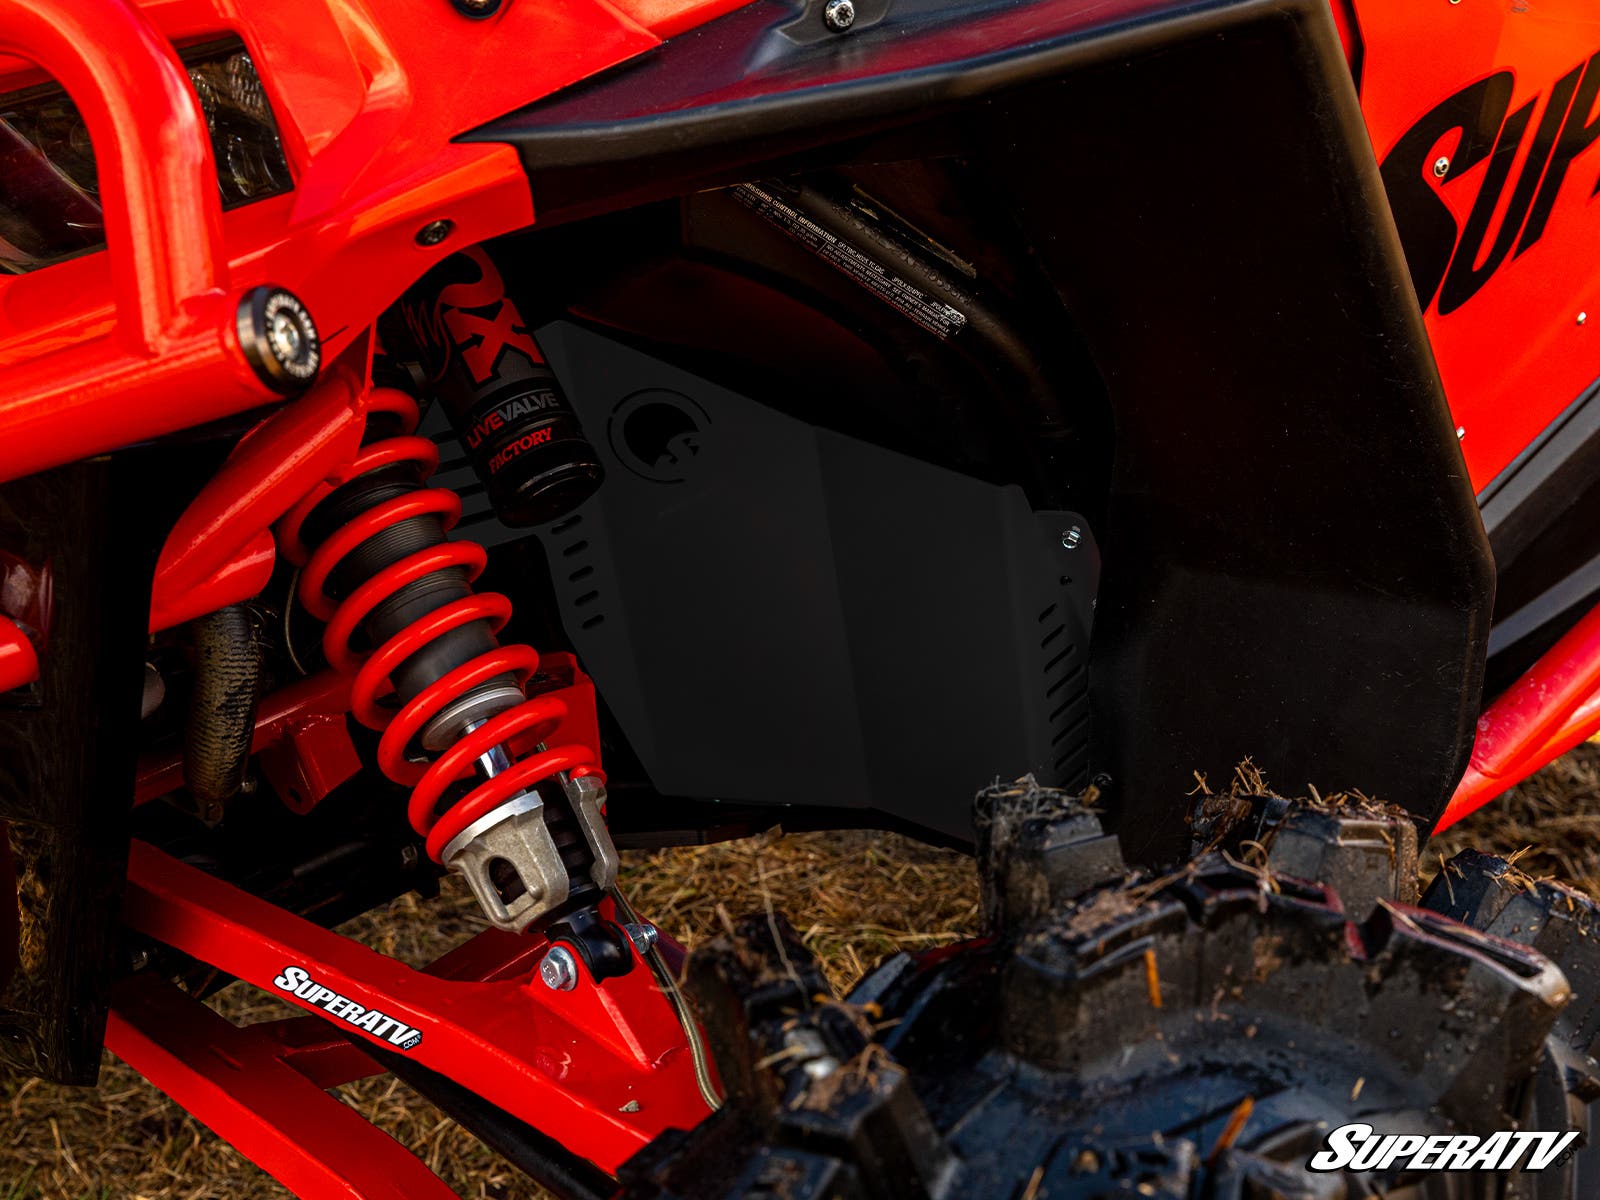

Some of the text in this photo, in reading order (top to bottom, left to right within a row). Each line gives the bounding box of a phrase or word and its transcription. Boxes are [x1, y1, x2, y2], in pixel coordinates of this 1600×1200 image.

[743, 183, 773, 202] MISSIONS
[772, 200, 798, 219] CONTROL
[797, 216, 837, 243] INFORMATION
[1379, 50, 1600, 316] SUP
[488, 426, 553, 475] FACTORY
